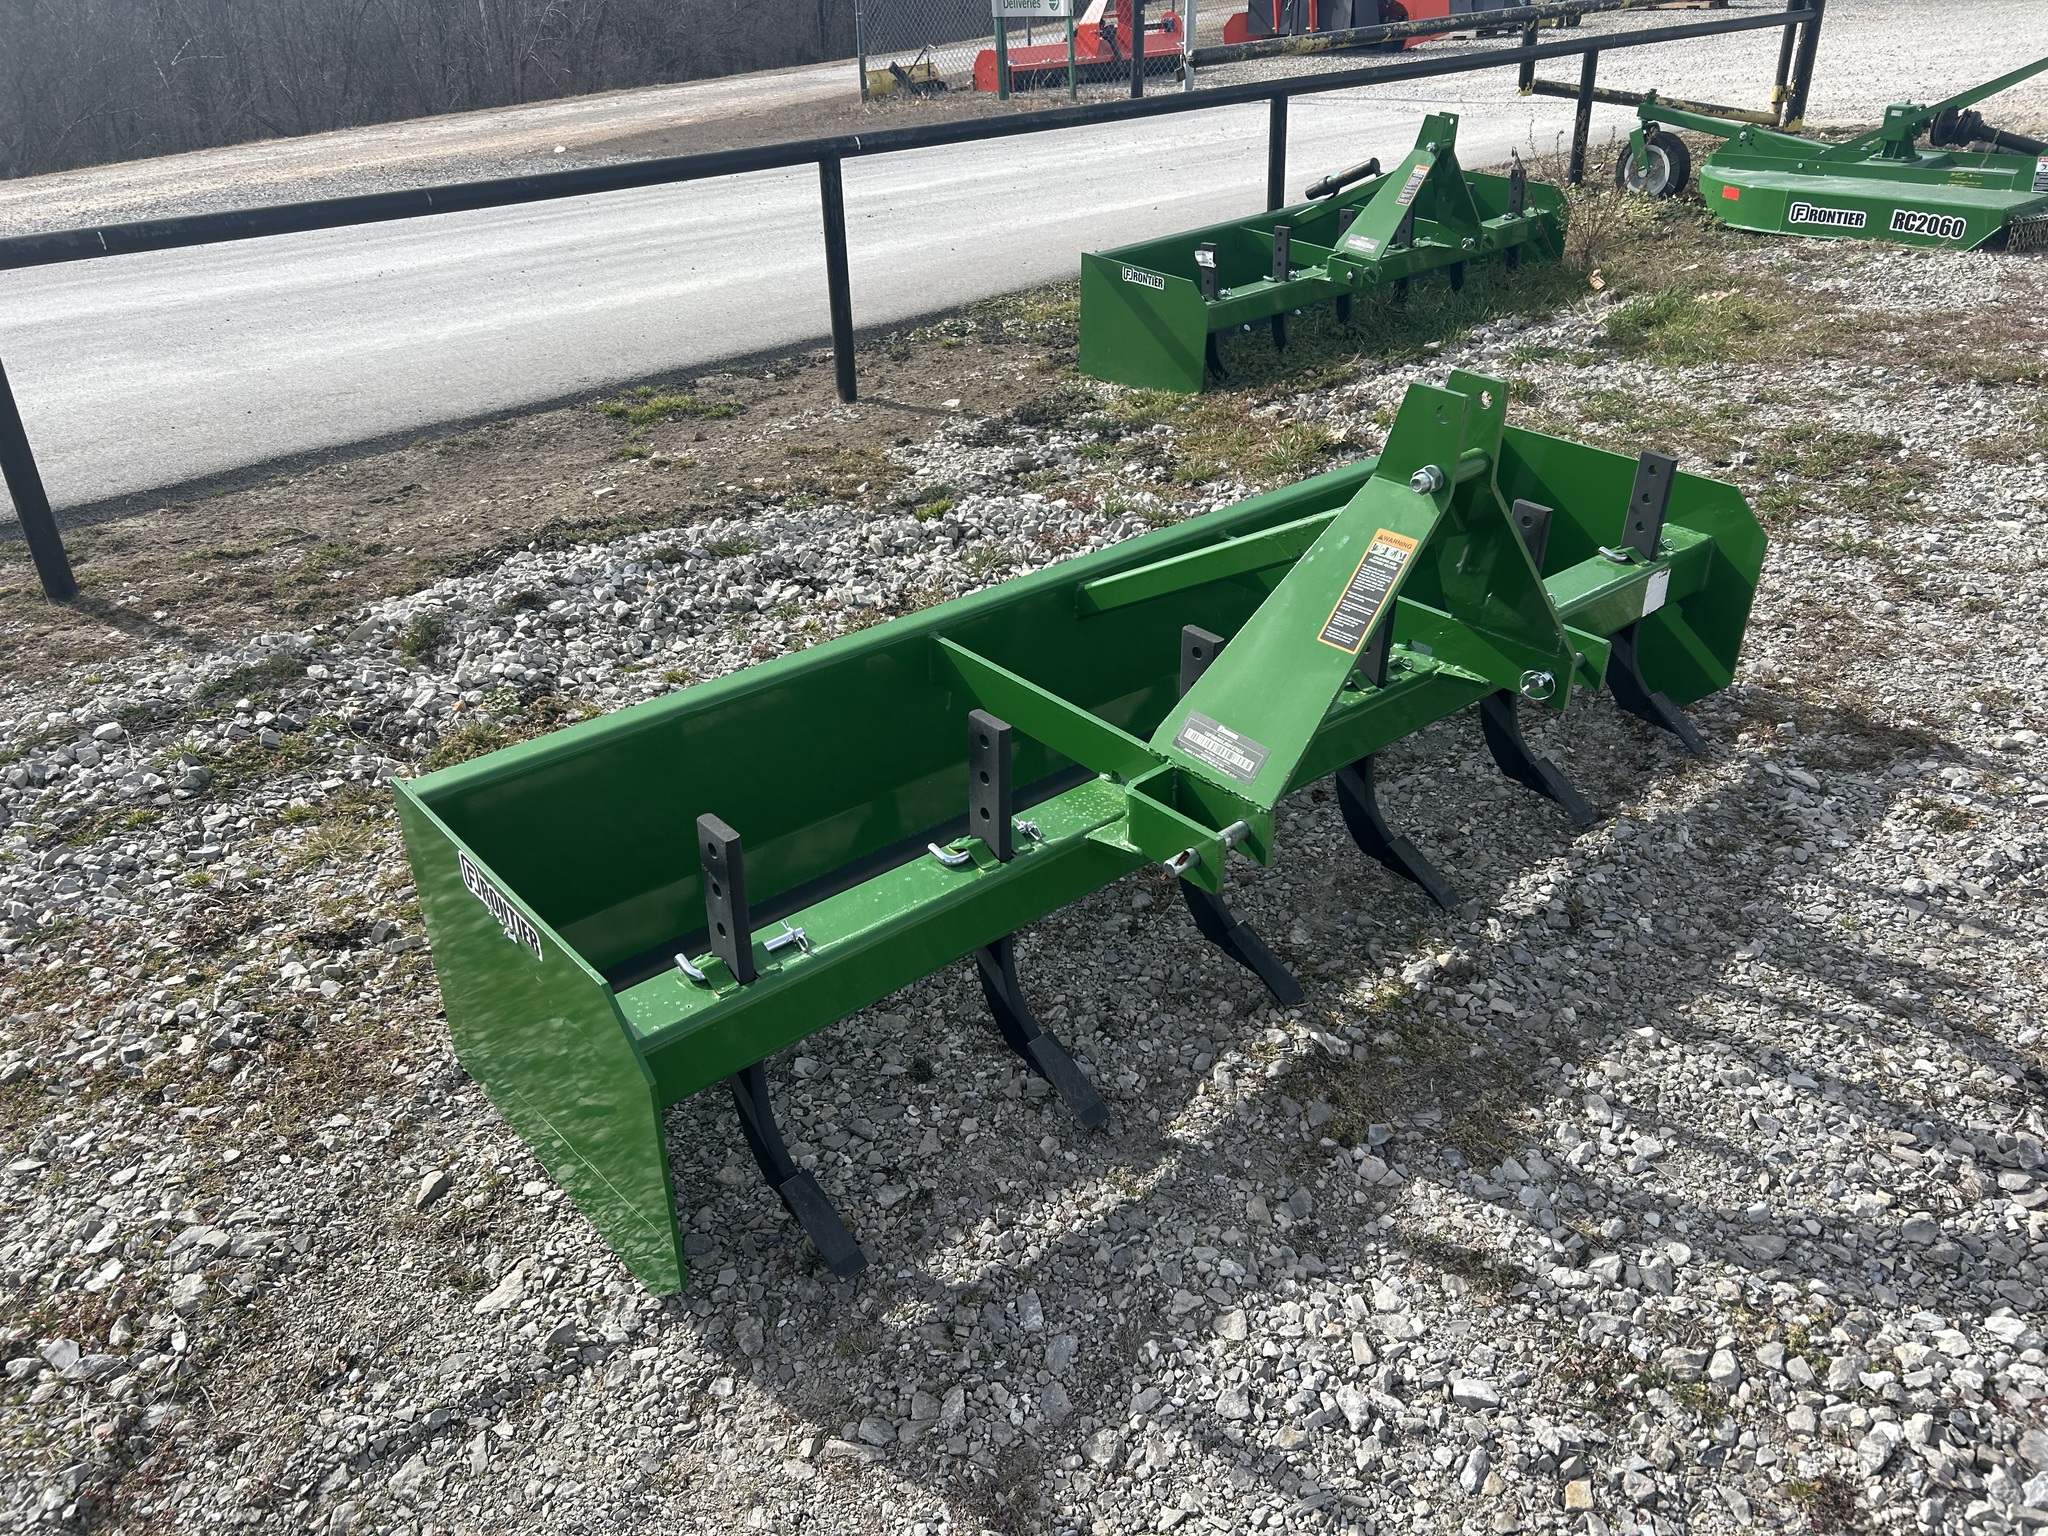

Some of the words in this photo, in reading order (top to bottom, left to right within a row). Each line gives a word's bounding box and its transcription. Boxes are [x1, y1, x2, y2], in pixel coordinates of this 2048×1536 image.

[1790, 203, 1865, 227] FRONTIER
[1891, 211, 1965, 238] RC2060
[1123, 267, 1165, 290] FRONTIER
[1383, 535, 1413, 550] WARNING
[460, 852, 541, 959] FRONTIER
